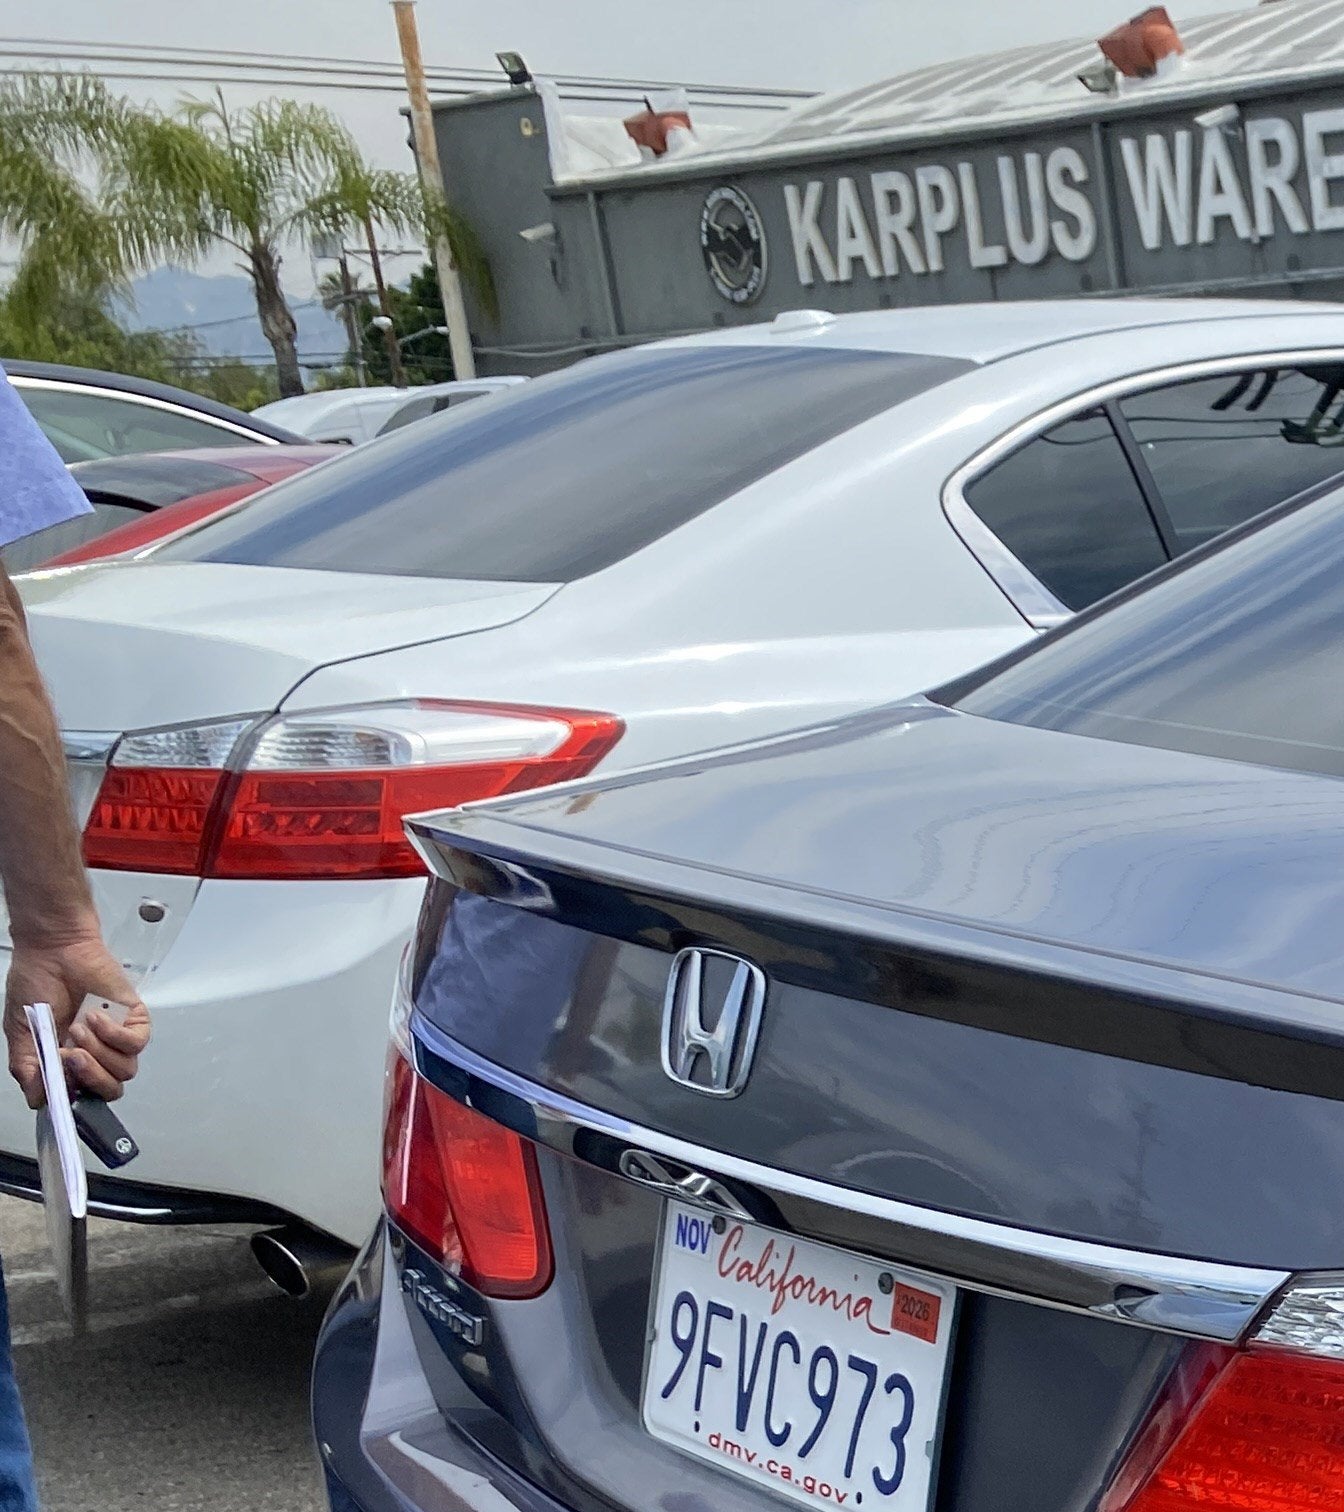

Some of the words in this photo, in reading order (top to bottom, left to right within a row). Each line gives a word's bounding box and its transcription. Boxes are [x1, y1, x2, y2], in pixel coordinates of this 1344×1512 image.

[784, 146, 1098, 288] KARPLUS
[675, 1212, 713, 1256] NOV
[717, 1225, 891, 1335] California
[901, 1293, 931, 1322] 2026
[660, 1290, 915, 1497] 9FVC973
[708, 1431, 849, 1505] dmv.ca.gov
